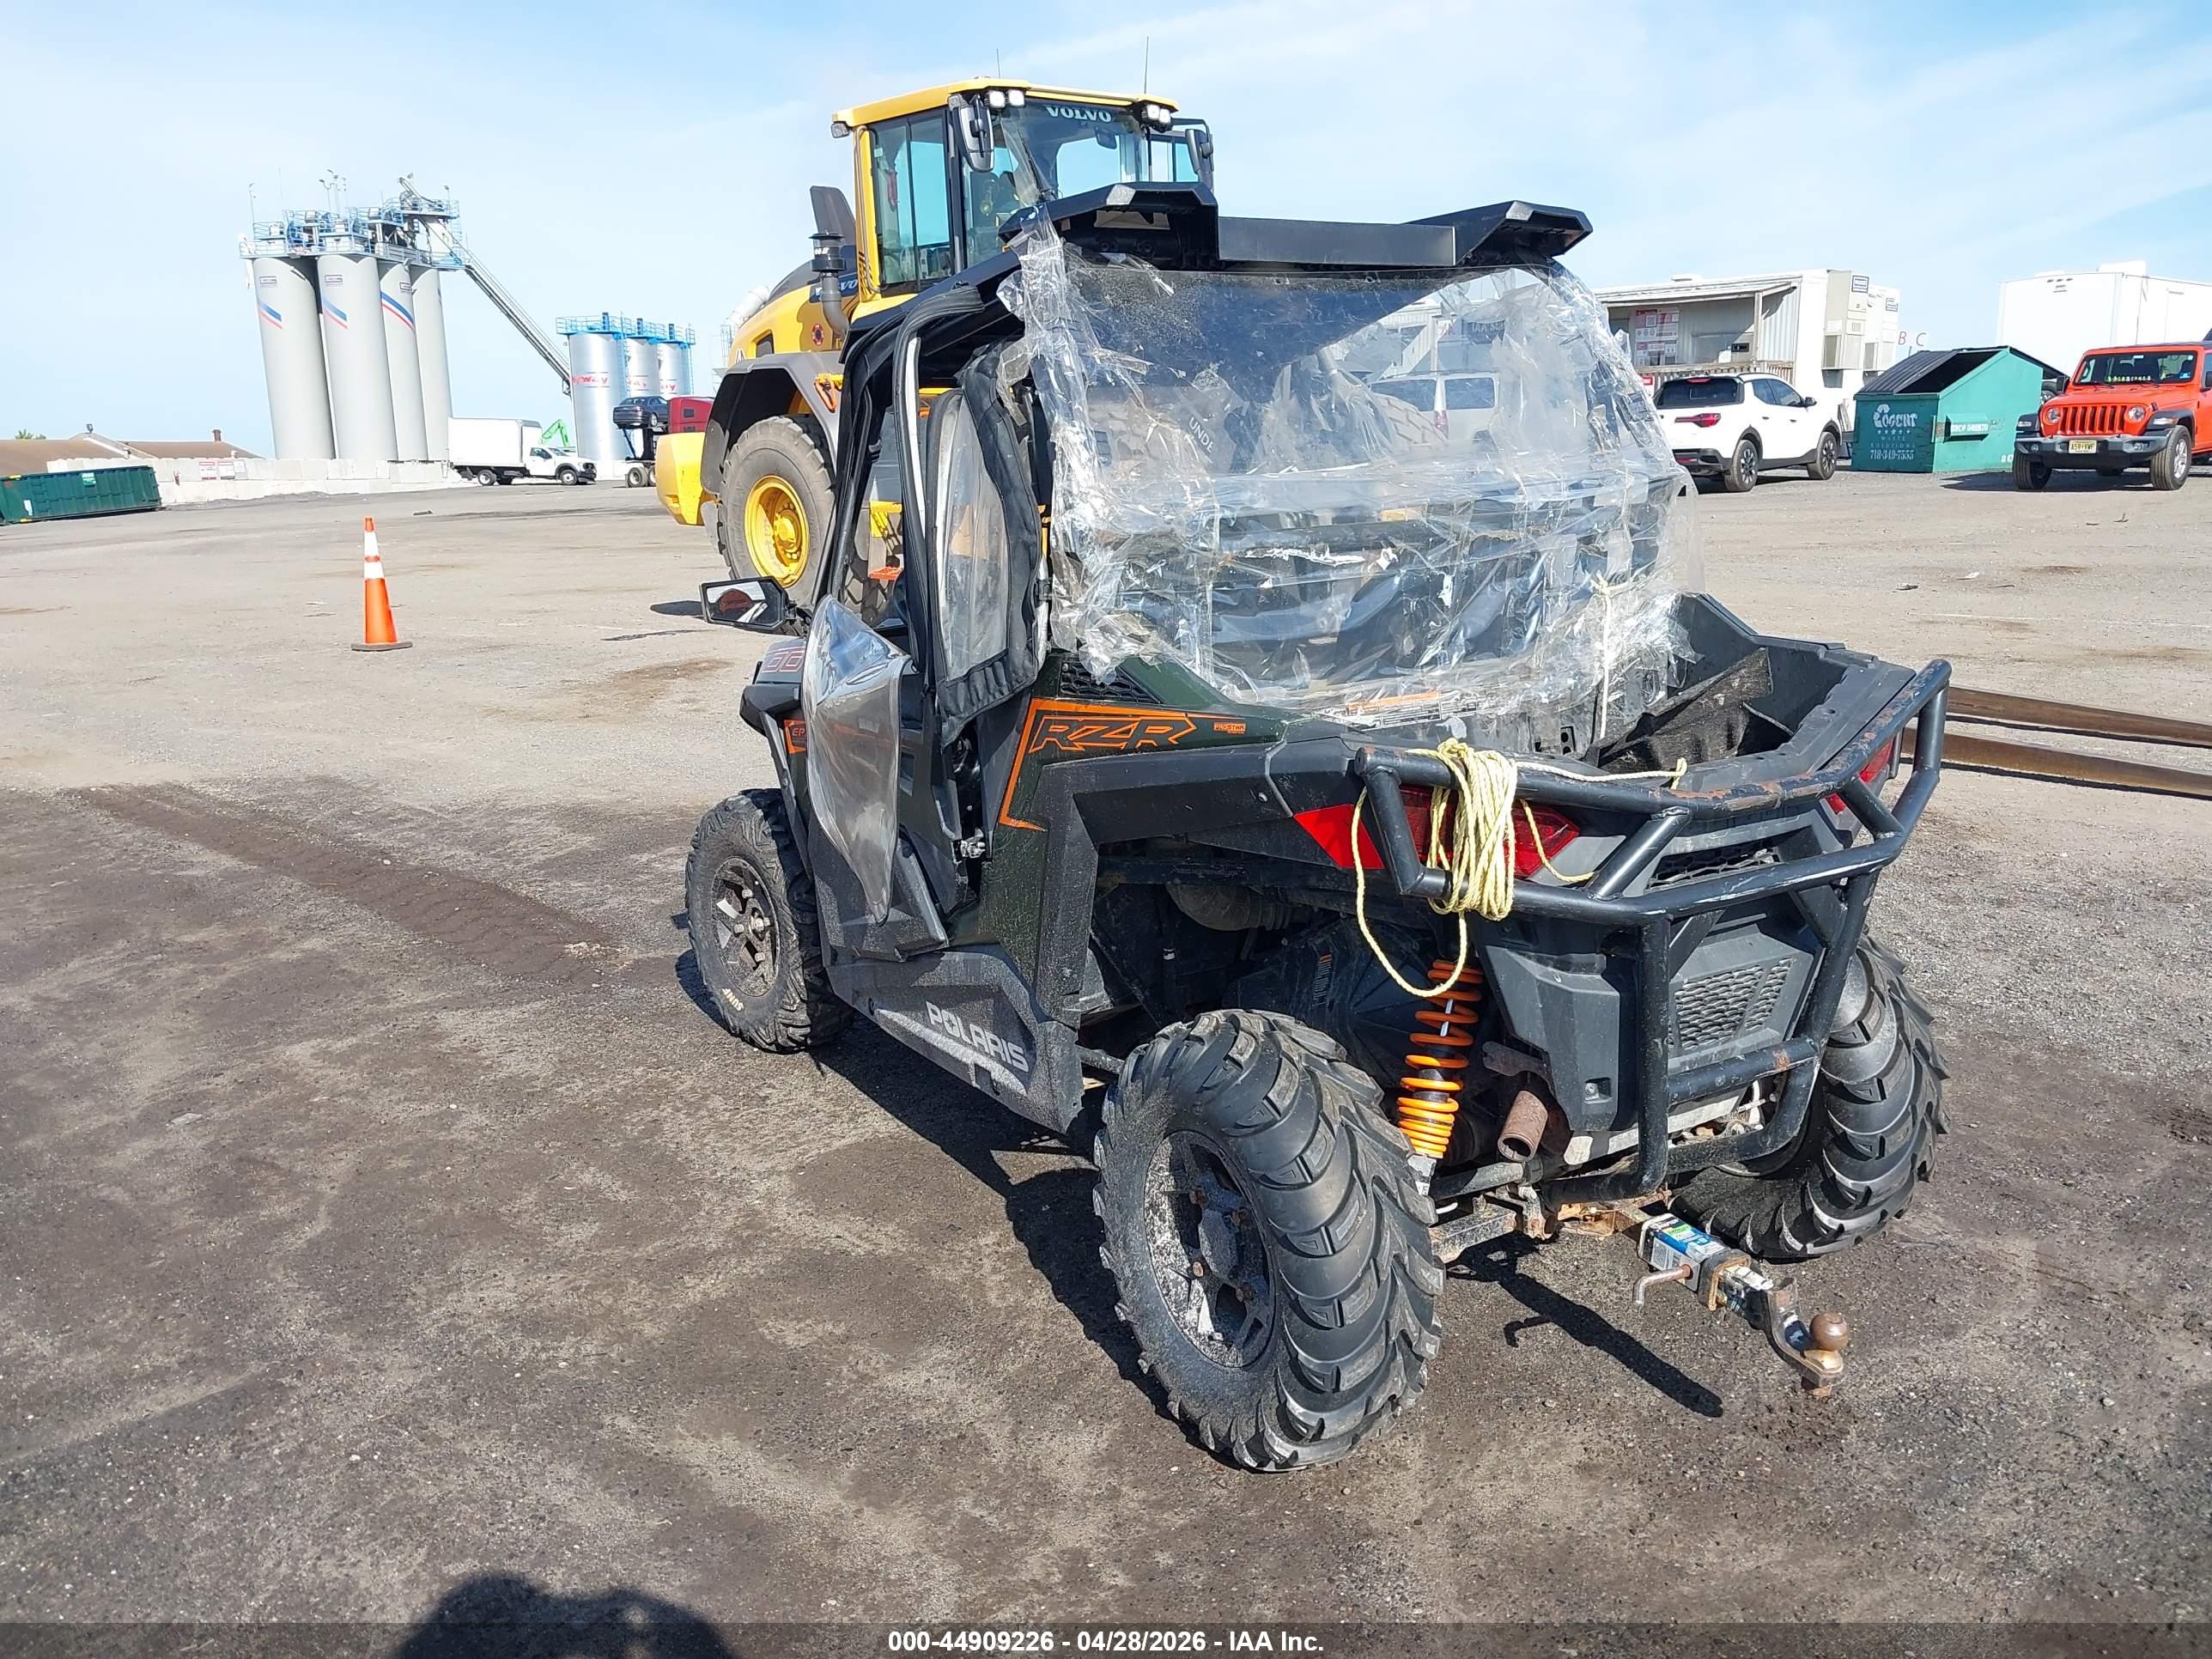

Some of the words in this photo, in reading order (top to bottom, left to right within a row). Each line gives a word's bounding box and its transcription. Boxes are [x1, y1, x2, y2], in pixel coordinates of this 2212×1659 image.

[1046, 106, 1112, 123] VOLVO
[1029, 715, 1196, 753] RZR
[1213, 722, 1246, 731] PROSTAR
[926, 1000, 1030, 1073] POLARIS
